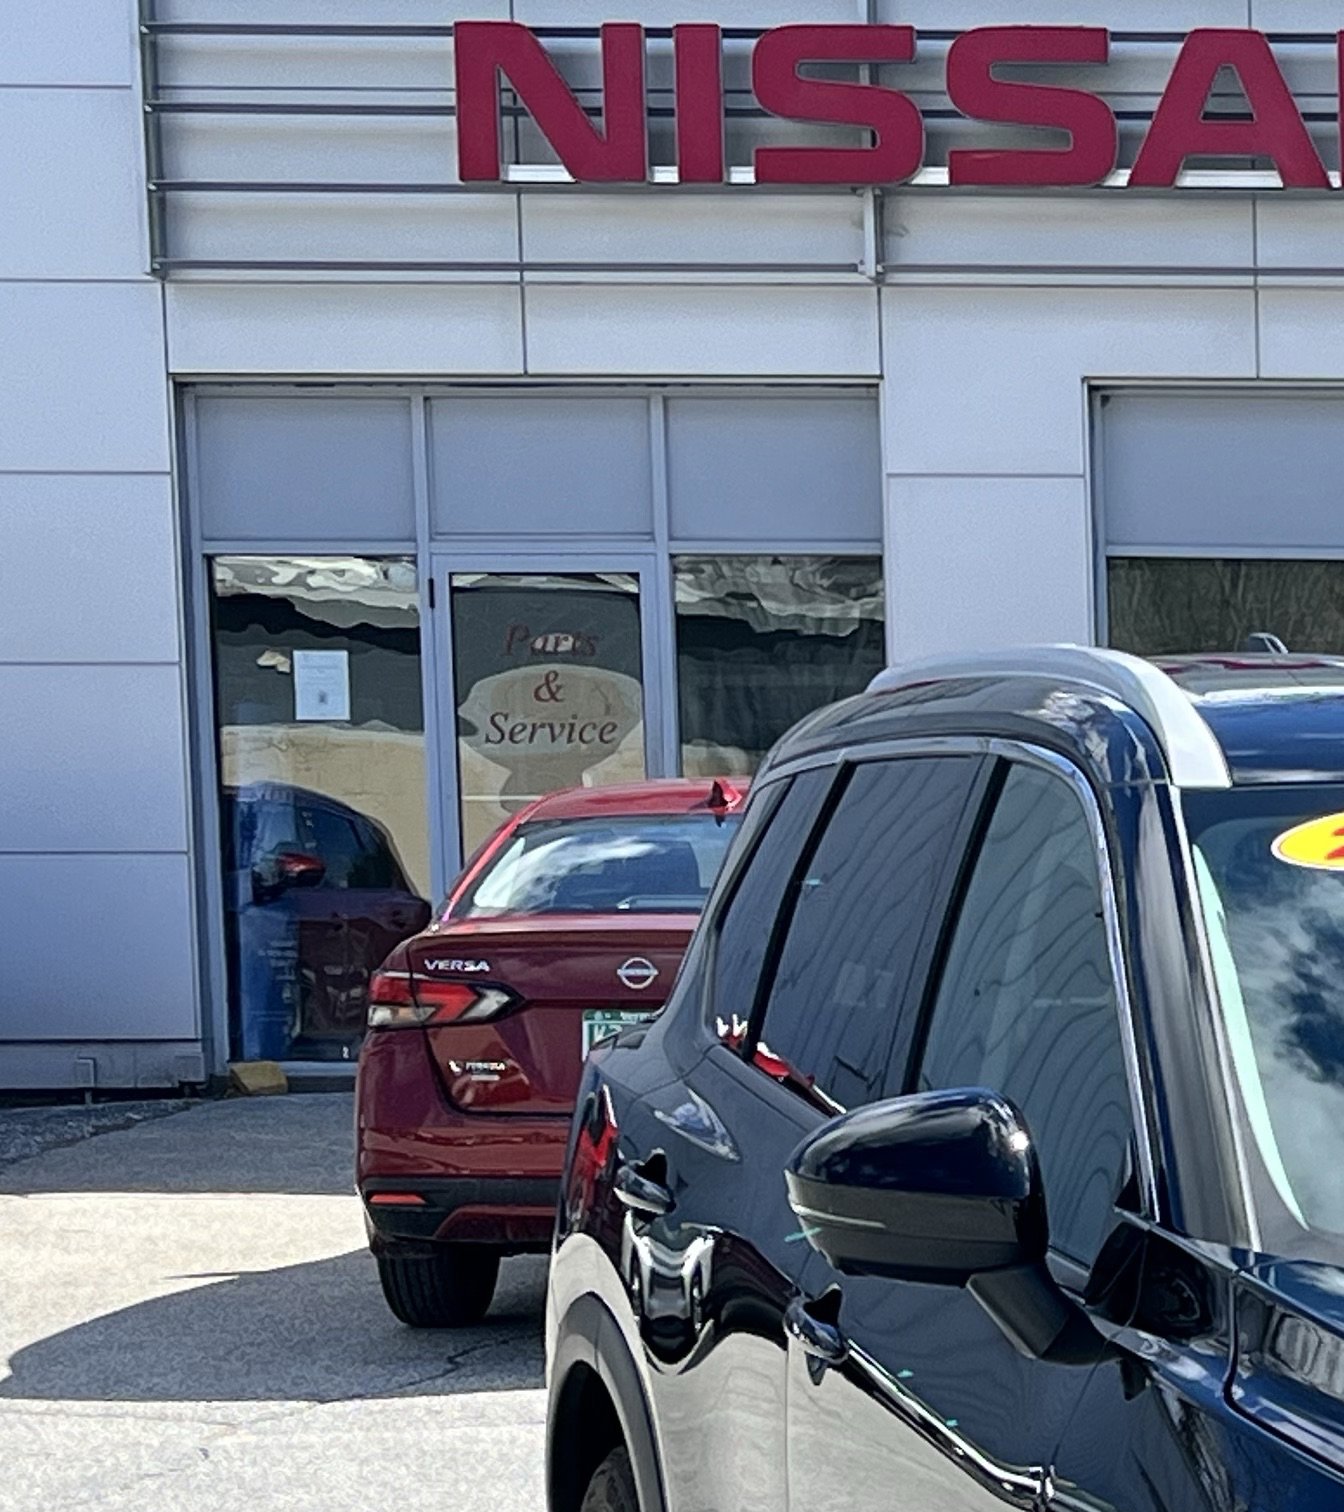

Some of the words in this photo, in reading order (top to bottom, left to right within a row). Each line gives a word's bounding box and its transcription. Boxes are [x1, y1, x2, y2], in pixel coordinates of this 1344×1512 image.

[502, 623, 599, 656] Parts
[533, 670, 565, 703] &
[484, 711, 618, 745] Service
[424, 959, 490, 972] VERSA
